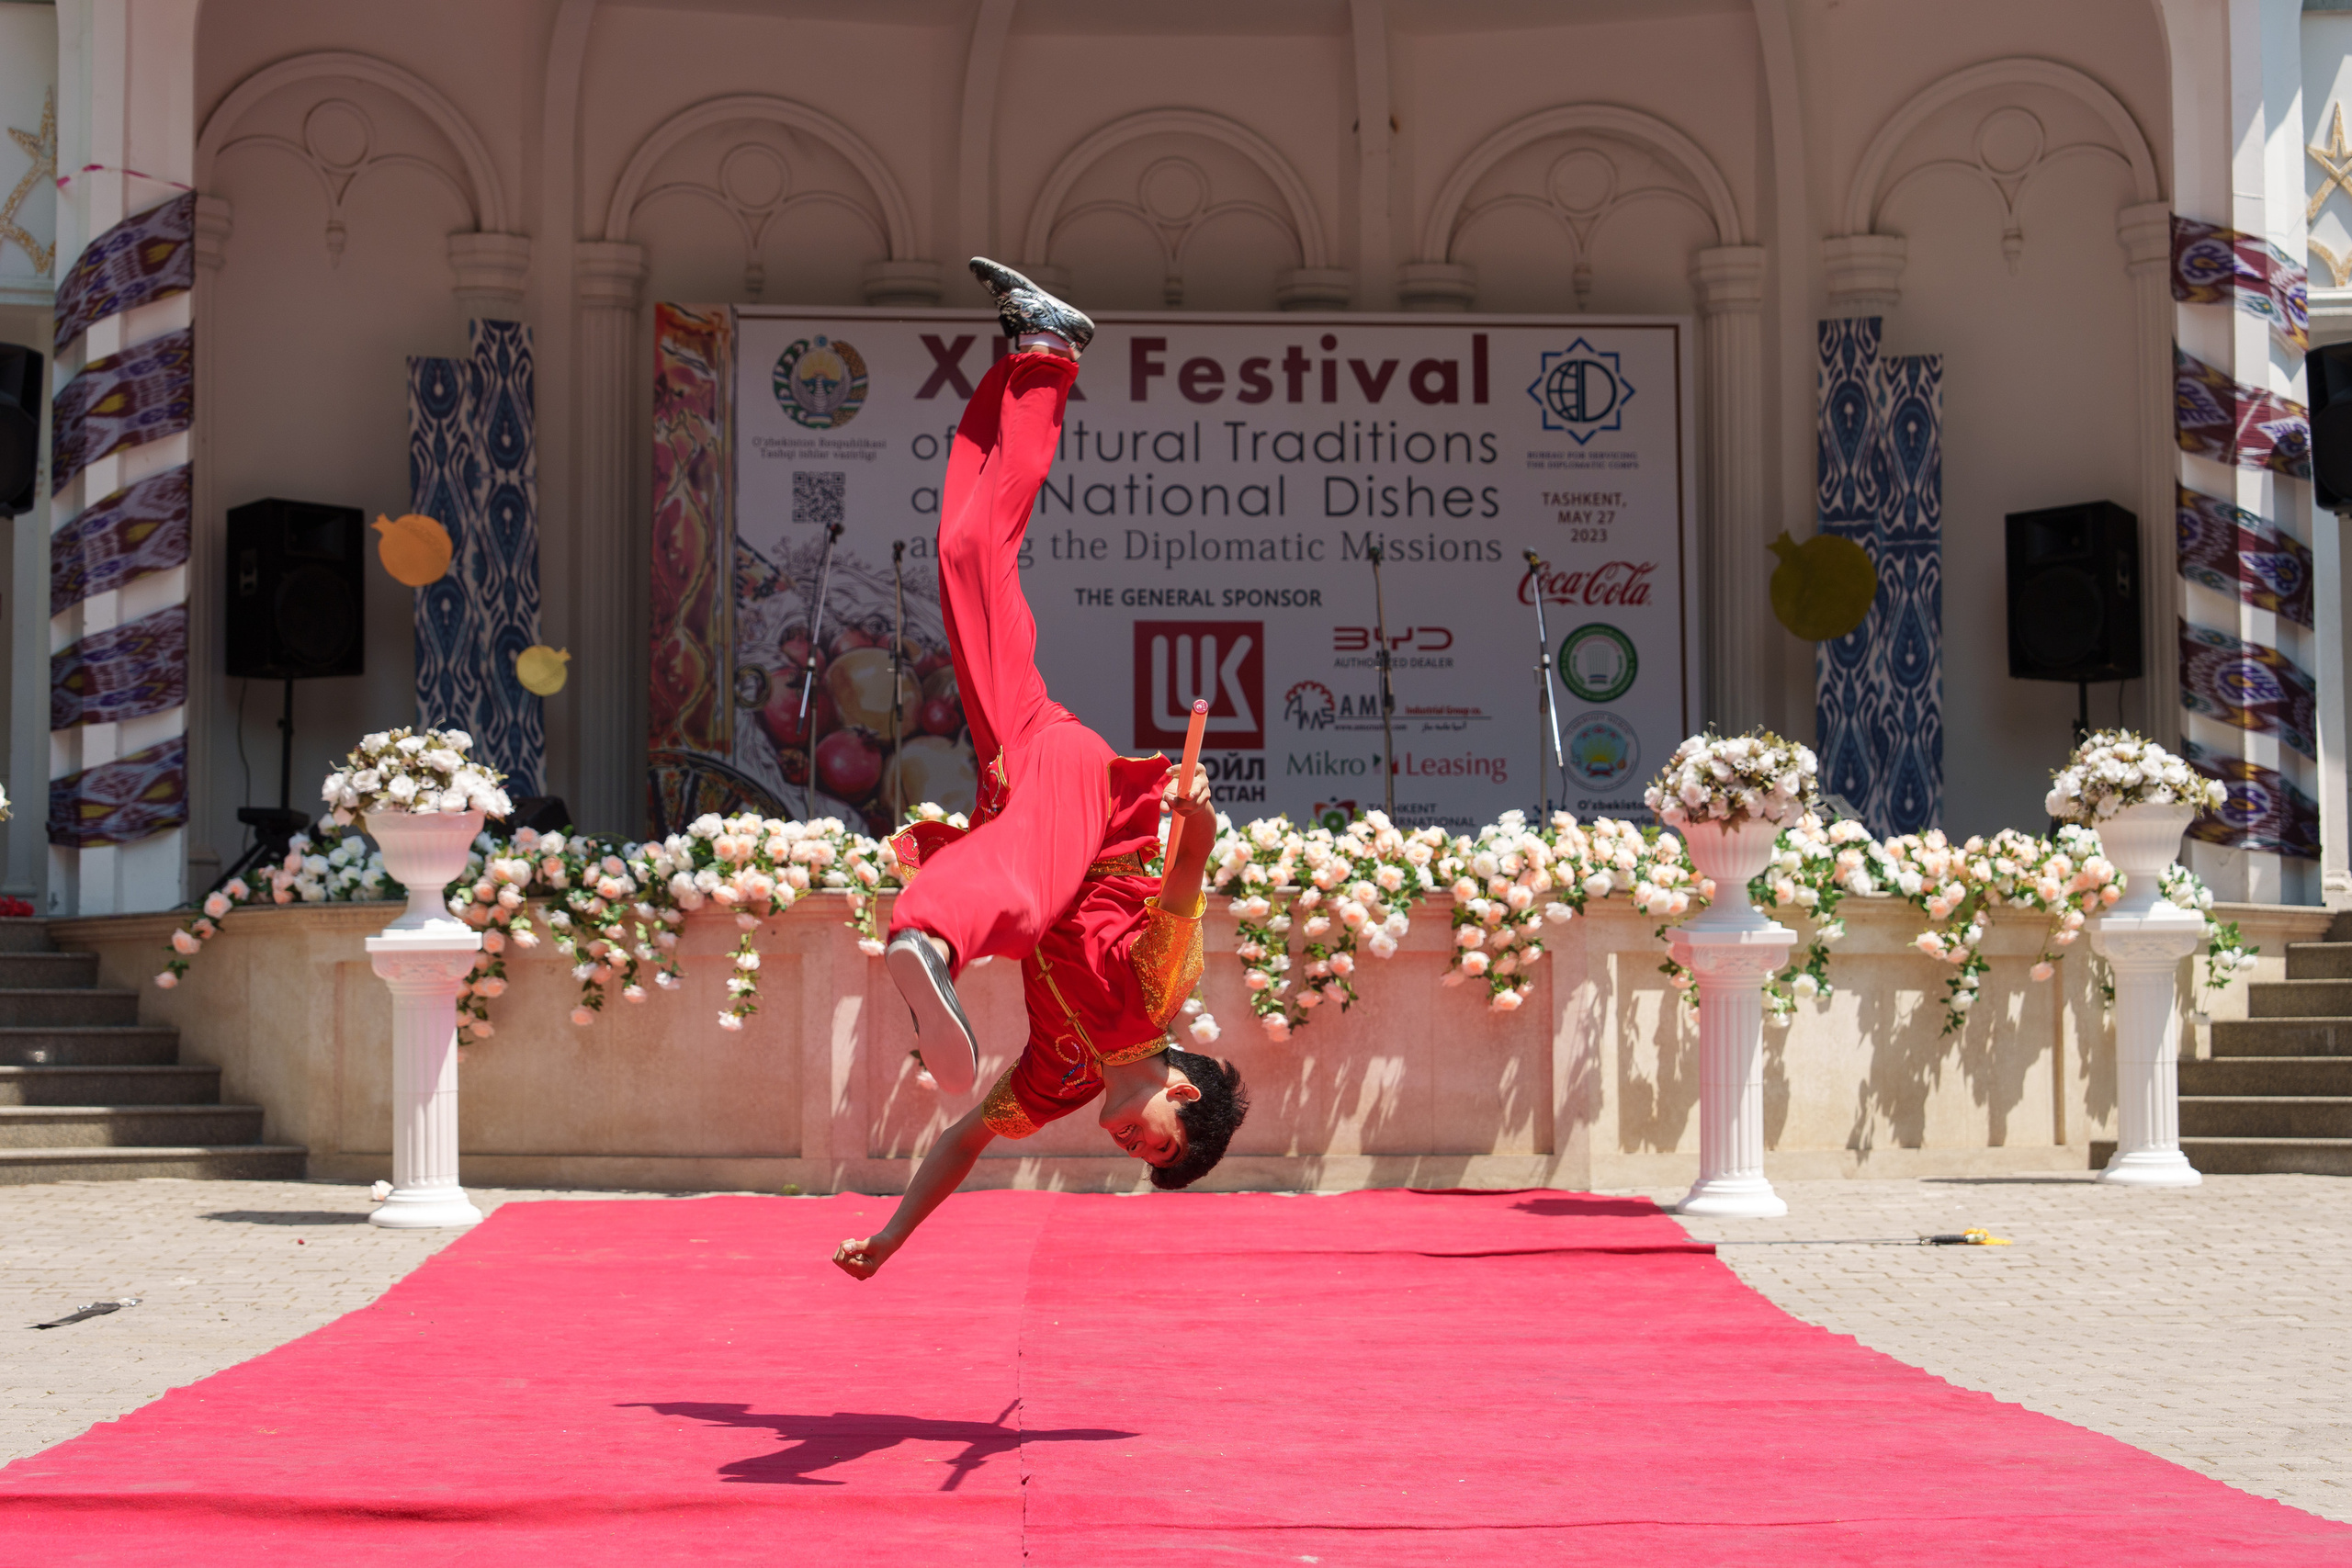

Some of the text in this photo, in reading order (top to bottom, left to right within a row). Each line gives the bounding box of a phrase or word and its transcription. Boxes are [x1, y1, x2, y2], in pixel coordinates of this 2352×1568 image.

[1130, 333, 1489, 405] Festival
[1059, 419, 1200, 463] ltural
[1224, 420, 1498, 464] Traditions
[1040, 472, 1499, 518] National Dishes
[1542, 491, 1627, 508] TASHKENT,
[1557, 510, 1615, 525] MAY 27
[1570, 528, 1608, 543] 2023
[1050, 528, 1108, 561] the
[1124, 529, 1326, 570] Diplomatic
[1340, 530, 1503, 563] Missions
[1074, 588, 1323, 607] THE GENERAL SPONSOR
[1334, 626, 1454, 651] BYD
[1409, 657, 1454, 669] DEALER
[1287, 751, 1509, 784] Mikro Leasing
